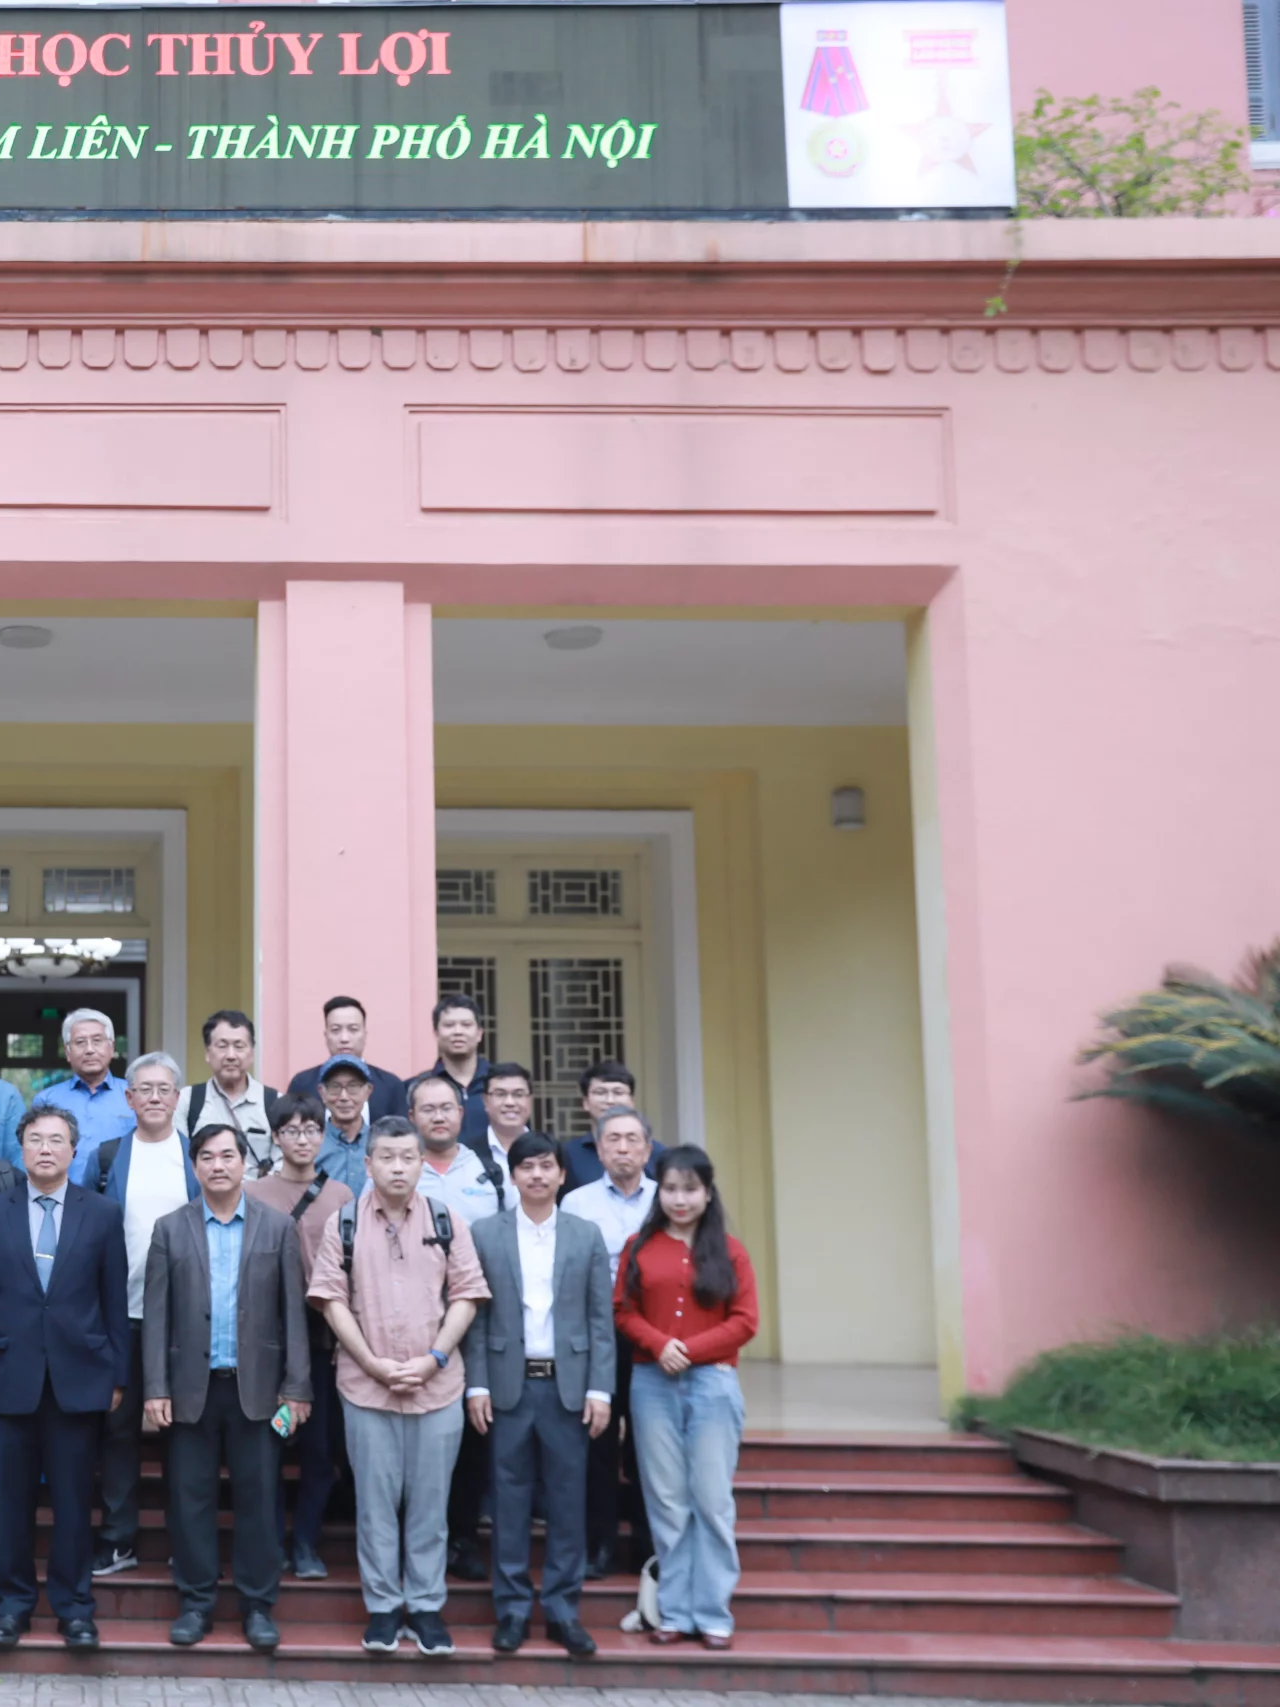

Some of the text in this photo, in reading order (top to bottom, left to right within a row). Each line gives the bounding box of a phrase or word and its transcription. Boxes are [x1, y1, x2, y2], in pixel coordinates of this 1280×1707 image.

[146, 21, 323, 76] THỦY
[338, 28, 451, 86] LỢI
[26, 114, 150, 161] LIÊN
[153, 142, 174, 153] -
[186, 115, 361, 161] THÀNH
[365, 115, 474, 160] PHỐ
[478, 113, 551, 160] HÀ
[561, 118, 658, 169] NỘI
